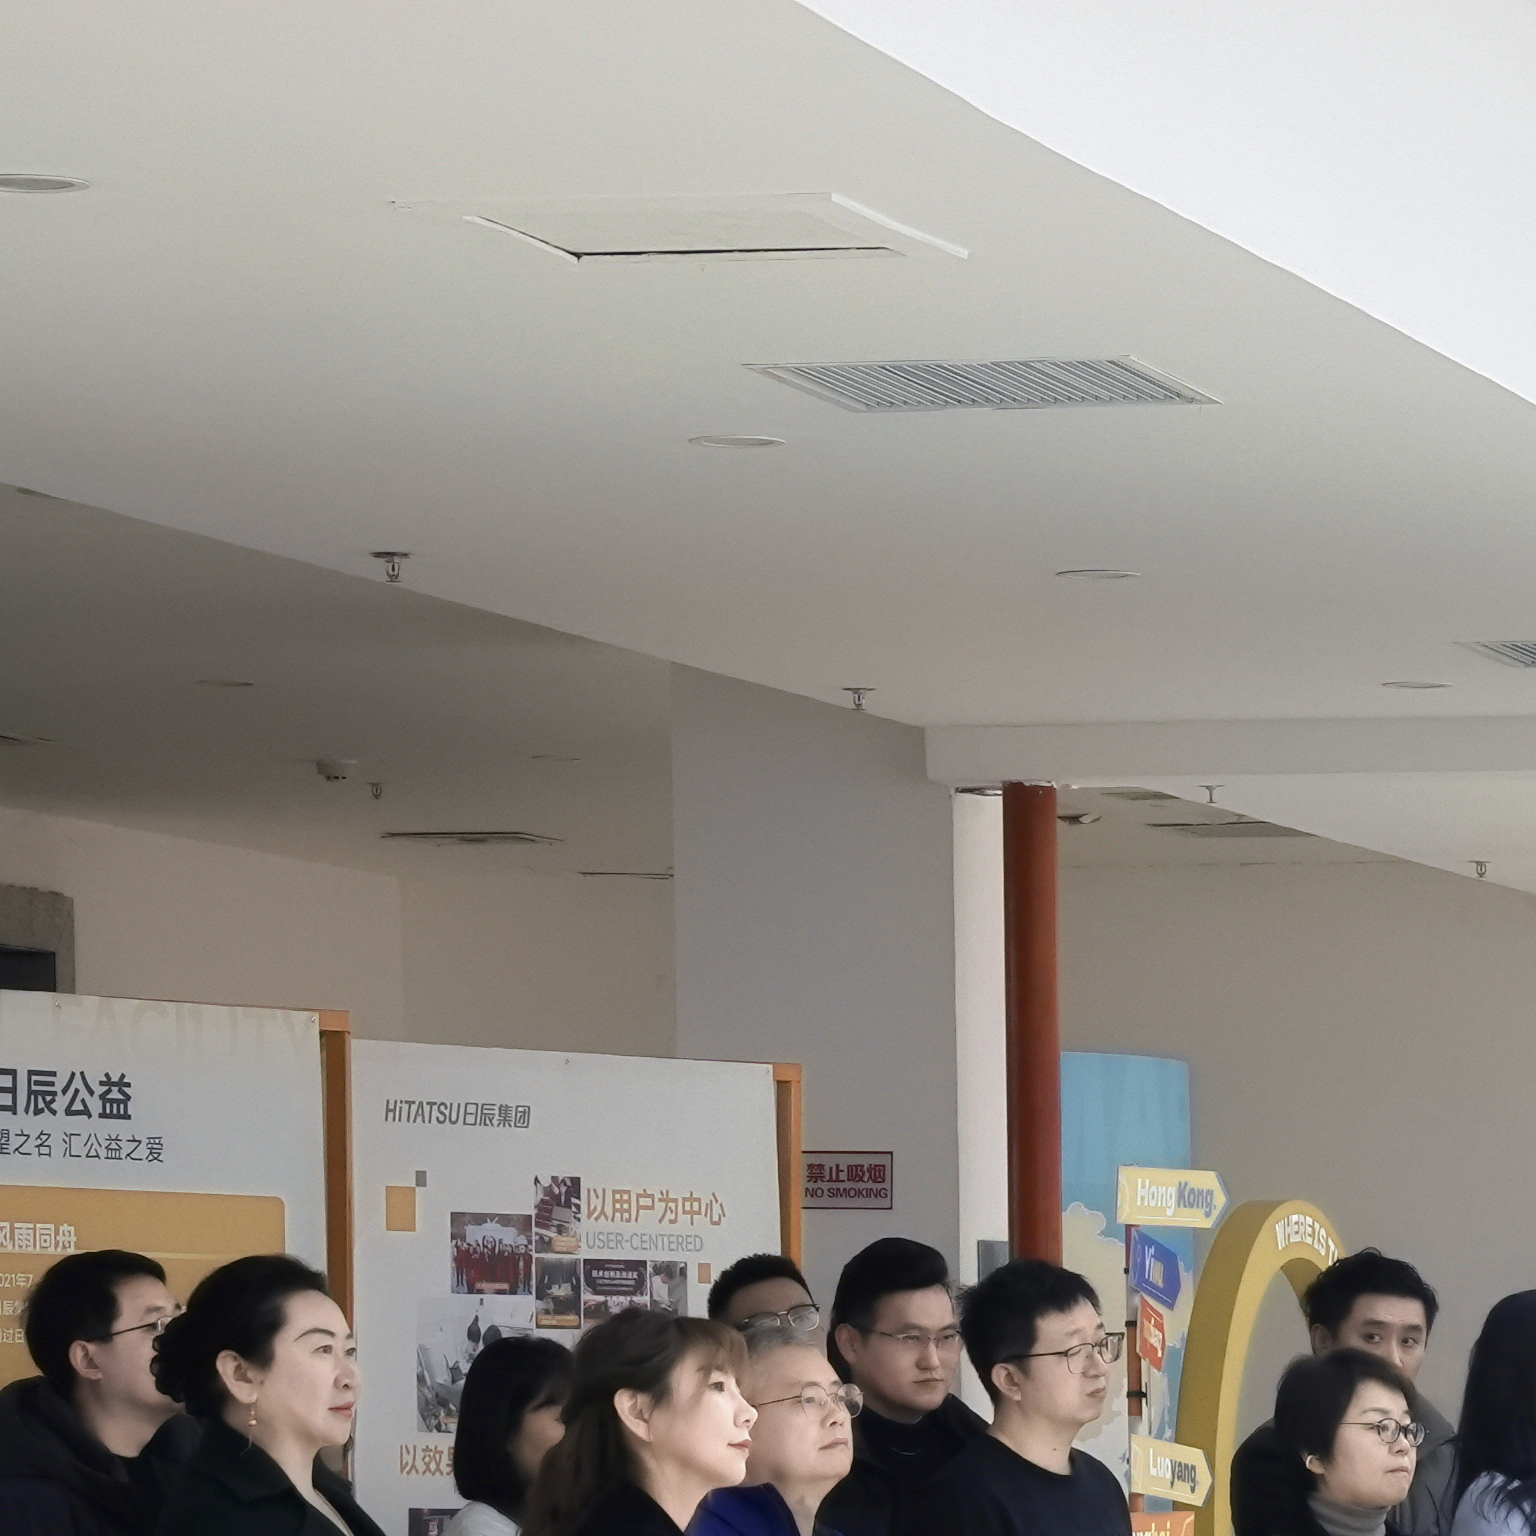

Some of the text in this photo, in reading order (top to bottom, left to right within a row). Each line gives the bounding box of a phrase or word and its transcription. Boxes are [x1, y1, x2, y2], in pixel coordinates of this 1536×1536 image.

[385, 1099, 531, 1129] HiTATSU 日辰集团
[62, 1131, 164, 1163] 汇公益之爱
[806, 1163, 886, 1183] 禁止吸烟
[585, 1187, 726, 1226] 以用户为中心
[805, 1187, 888, 1199] NO SMOKING
[585, 1231, 704, 1252] USER-CENTERED
[1275, 1213, 1313, 1250] WHERE
